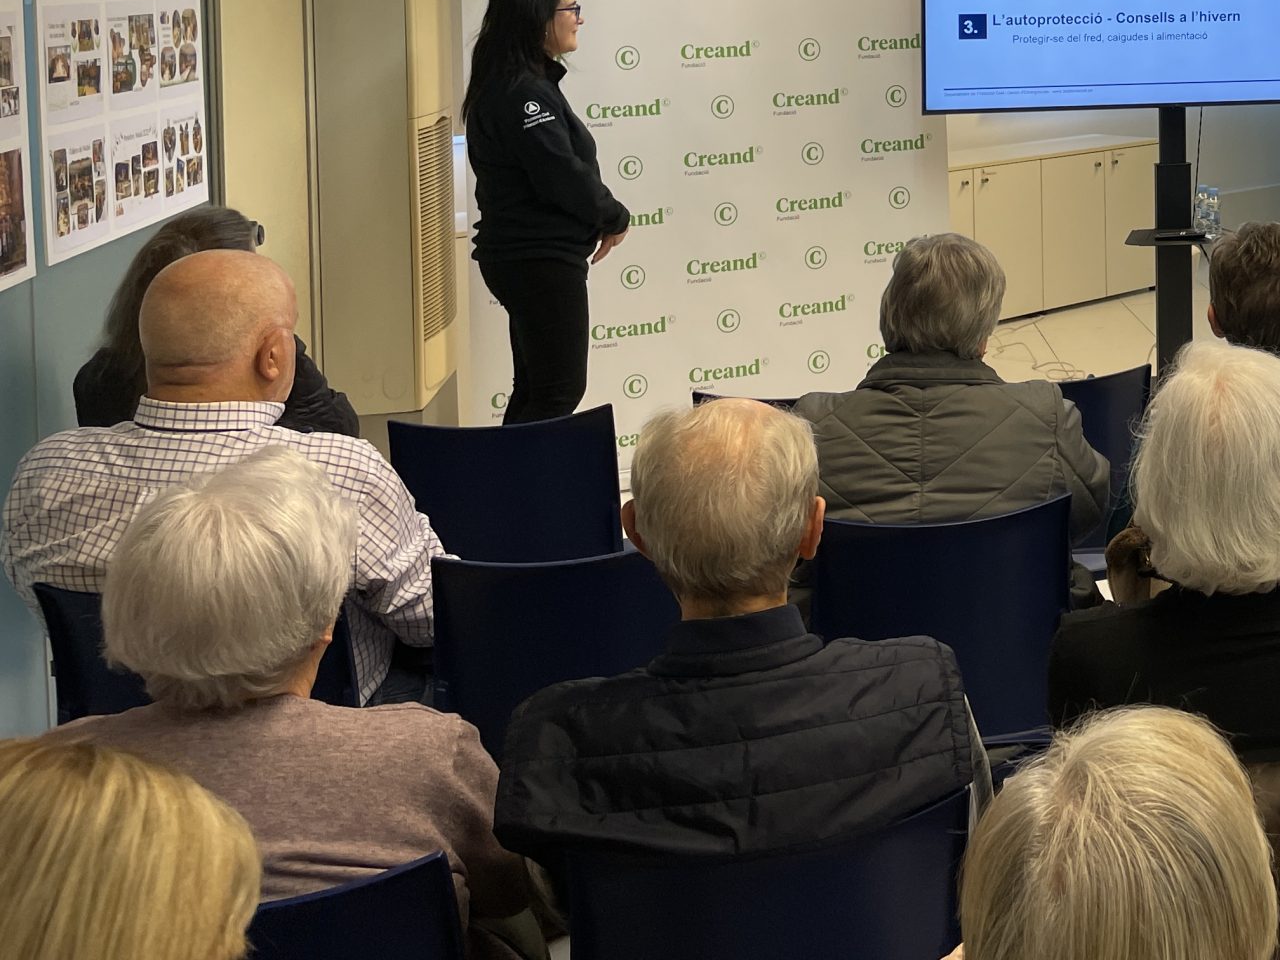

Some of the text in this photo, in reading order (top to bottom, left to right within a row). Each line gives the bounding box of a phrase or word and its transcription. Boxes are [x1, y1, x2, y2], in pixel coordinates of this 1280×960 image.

[963, 21, 978, 34] 3.
[1116, 11, 1175, 24] Consells
[1180, 14, 1187, 23] a
[1012, 34, 1064, 46] Protegir-se
[1067, 34, 1081, 43] del
[1084, 33, 1104, 43] fred,
[1107, 32, 1148, 44] caigudes
[1157, 32, 1208, 41] alimentació
